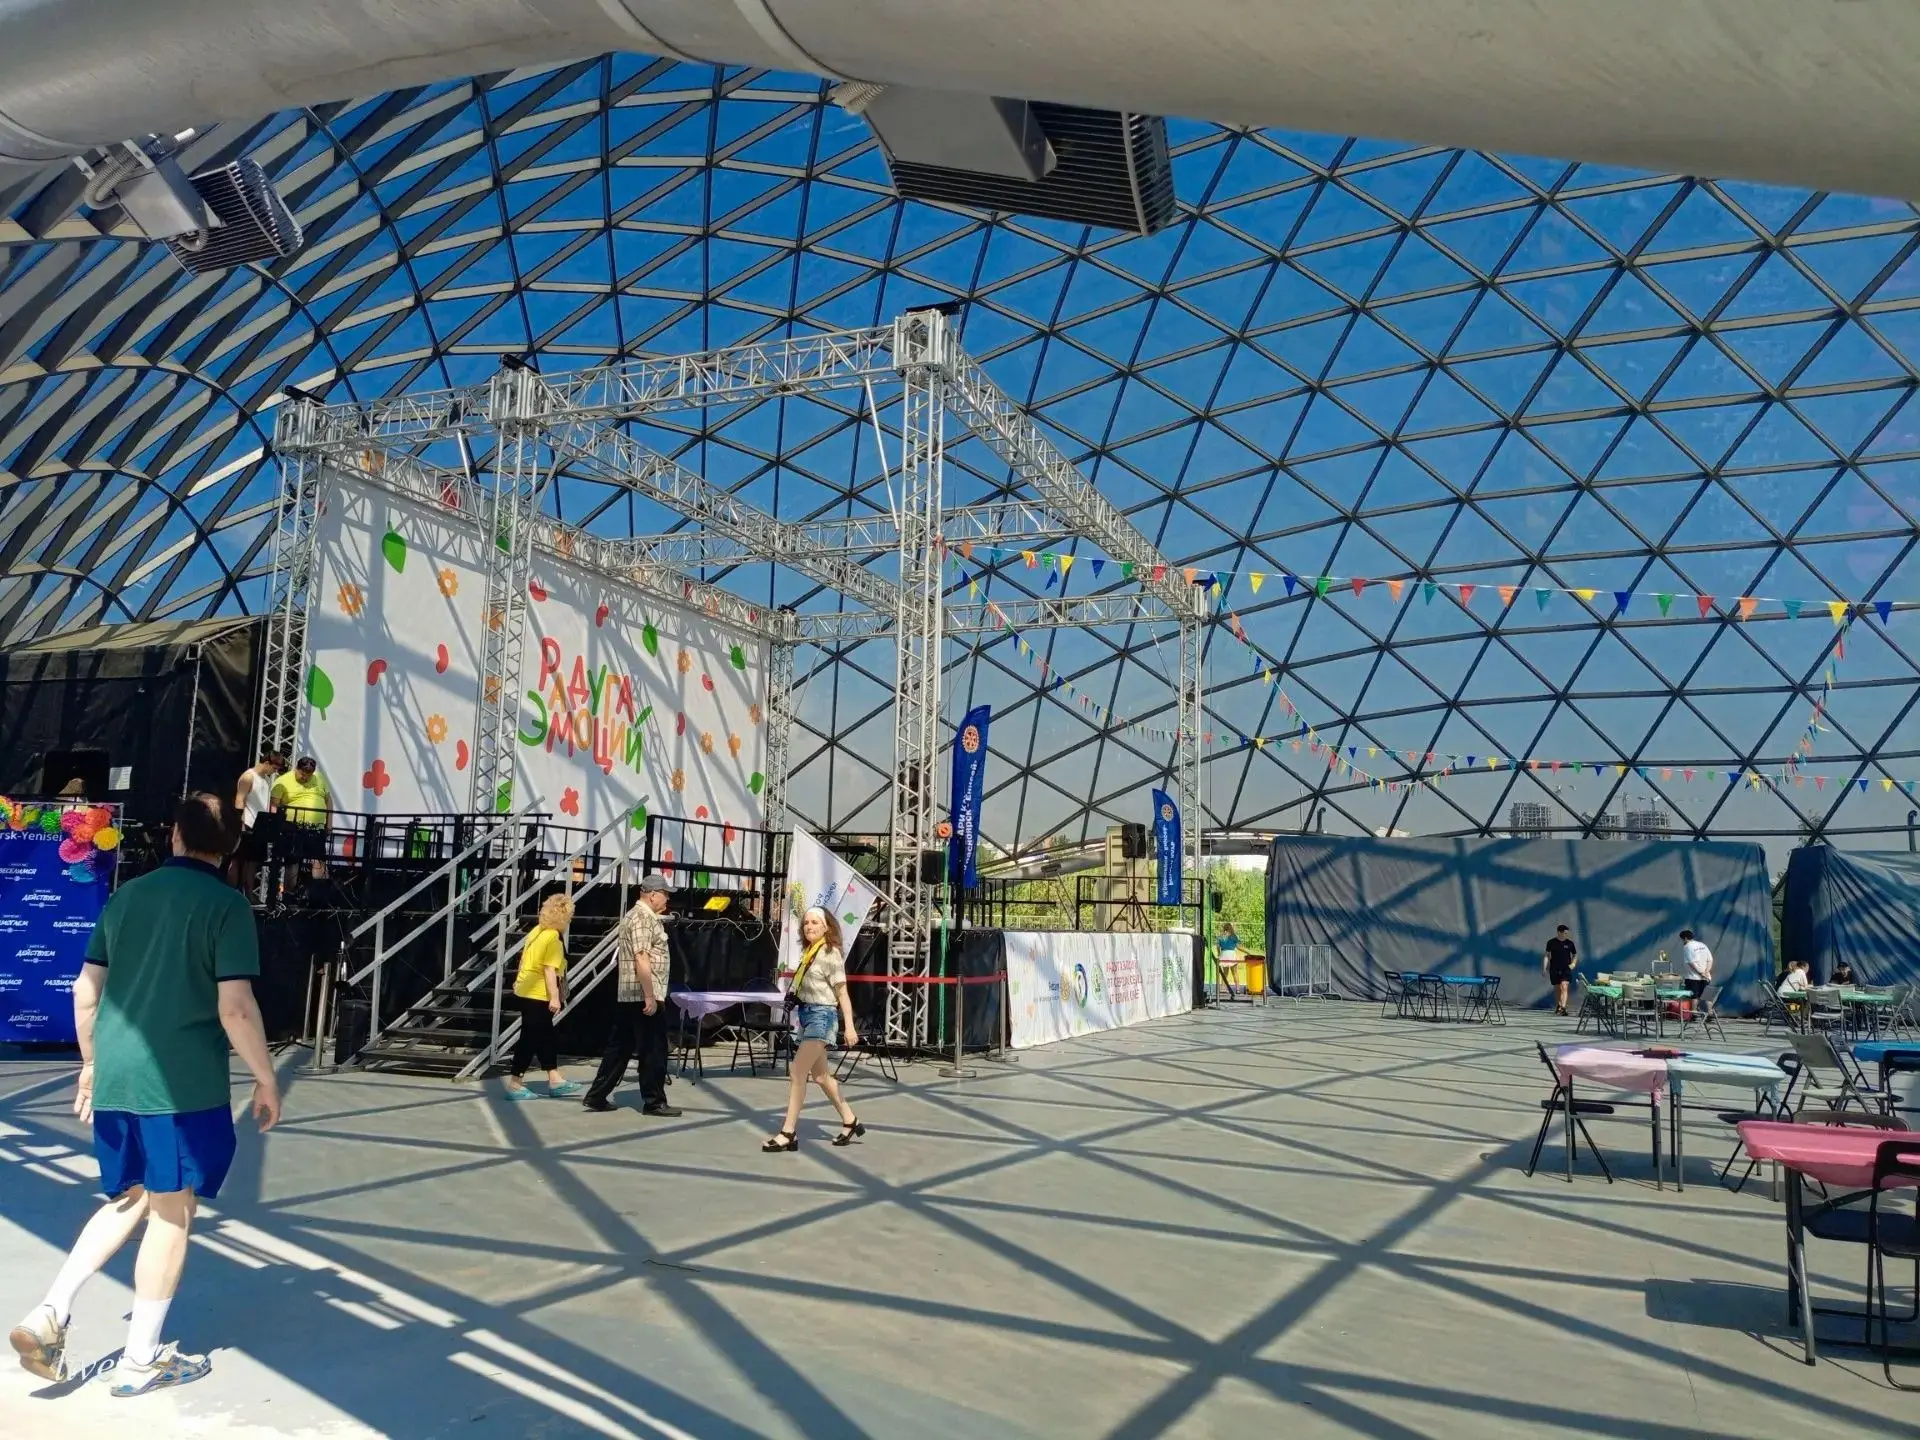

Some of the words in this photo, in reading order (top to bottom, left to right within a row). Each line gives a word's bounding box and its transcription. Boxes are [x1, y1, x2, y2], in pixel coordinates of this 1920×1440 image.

[538, 637, 634, 724] РАДУГА
[518, 689, 653, 776] ЭМОЦИЙ
[15, 948, 56, 957] ДЕЙСТВУЕМ
[7, 1013, 49, 1023] ДЕЙСТВУЕМ
